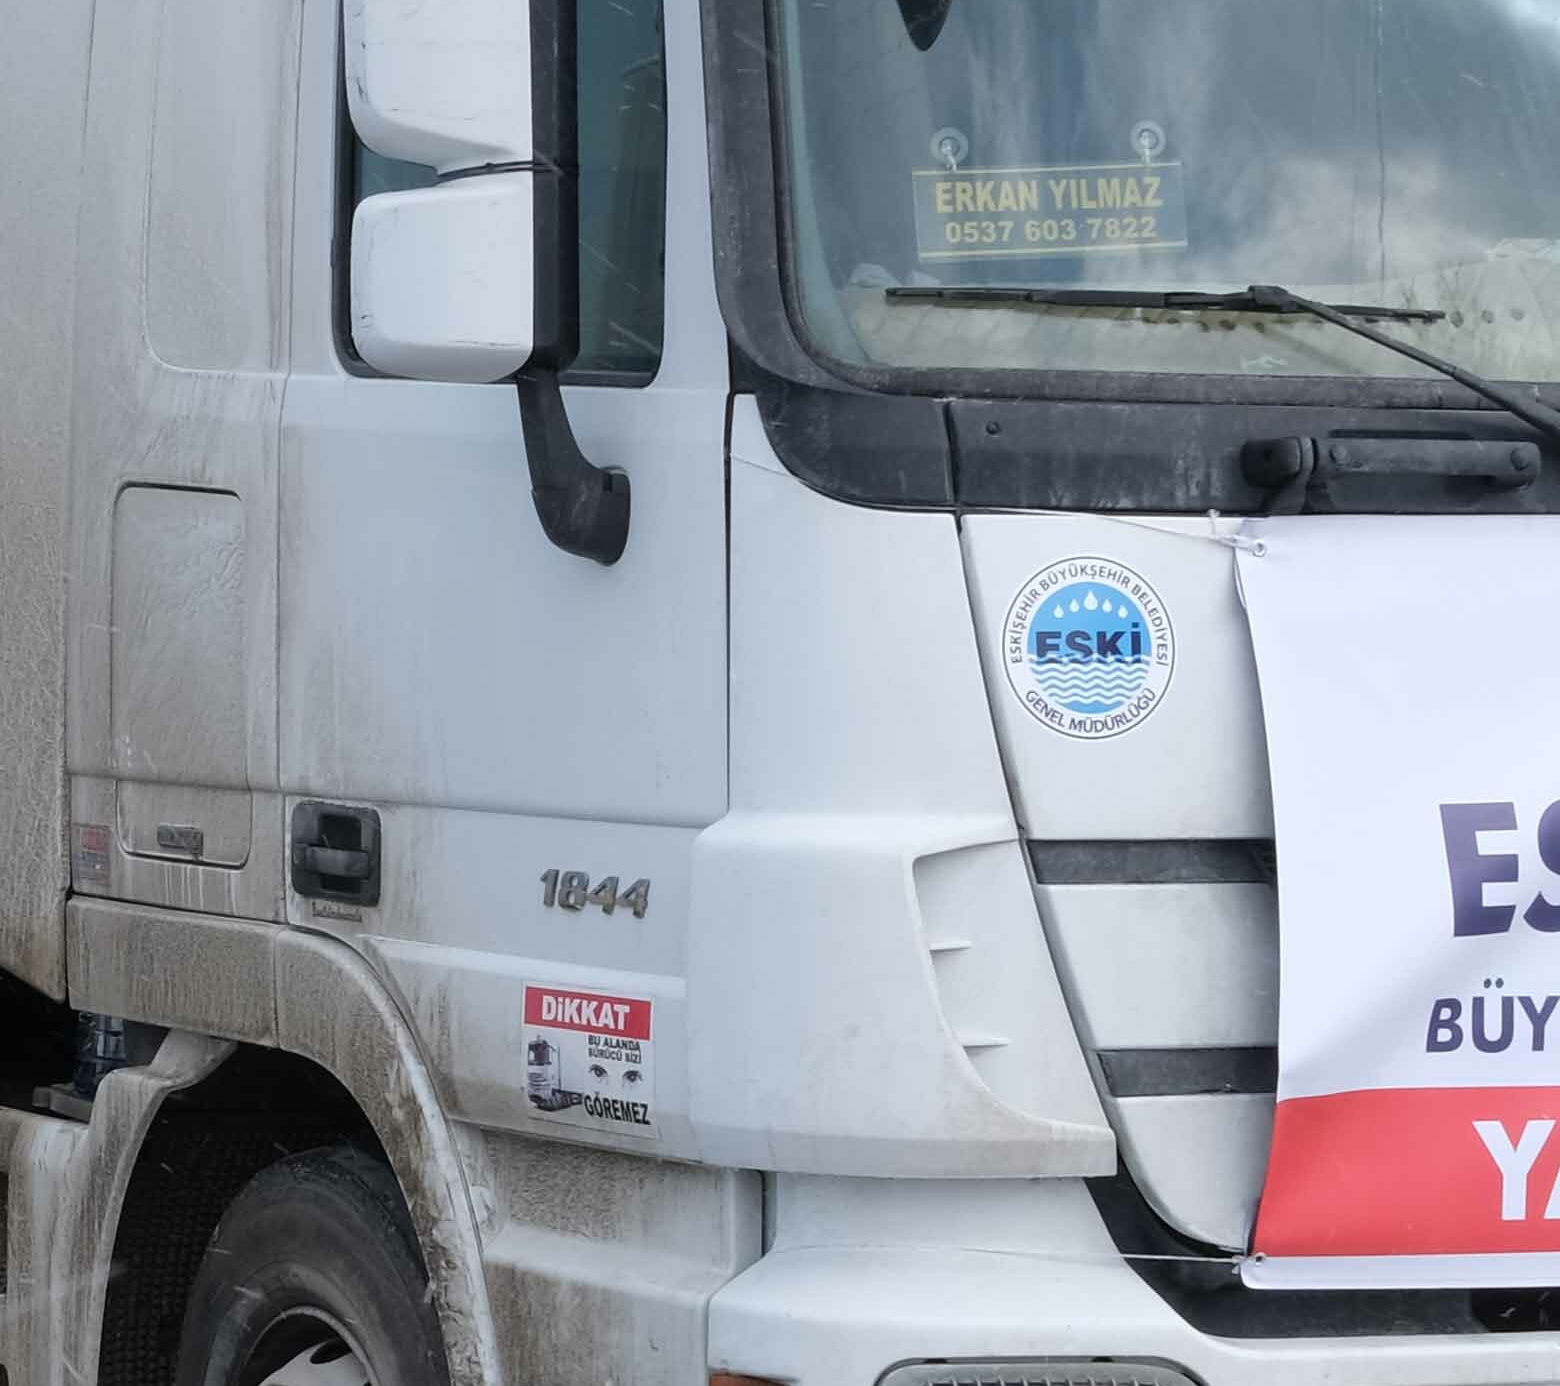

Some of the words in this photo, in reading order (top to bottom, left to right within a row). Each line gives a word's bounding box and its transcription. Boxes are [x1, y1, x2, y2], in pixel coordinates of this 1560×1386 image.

[935, 180, 1040, 214] ERKAN
[1048, 176, 1164, 210] YILMAZ
[944, 221, 1014, 244] 0537
[1025, 218, 1077, 242] 603
[1087, 216, 1158, 239] 7822
[1010, 587, 1042, 664] ESKİŞEHİR
[1039, 562, 1131, 592] BÜYÜKŞEHİR
[1035, 622, 1143, 663] ESKİ
[1025, 689, 1066, 727] GENEL
[540, 868, 650, 919] 1844
[583, 1091, 651, 1125] GÖREMEZ
